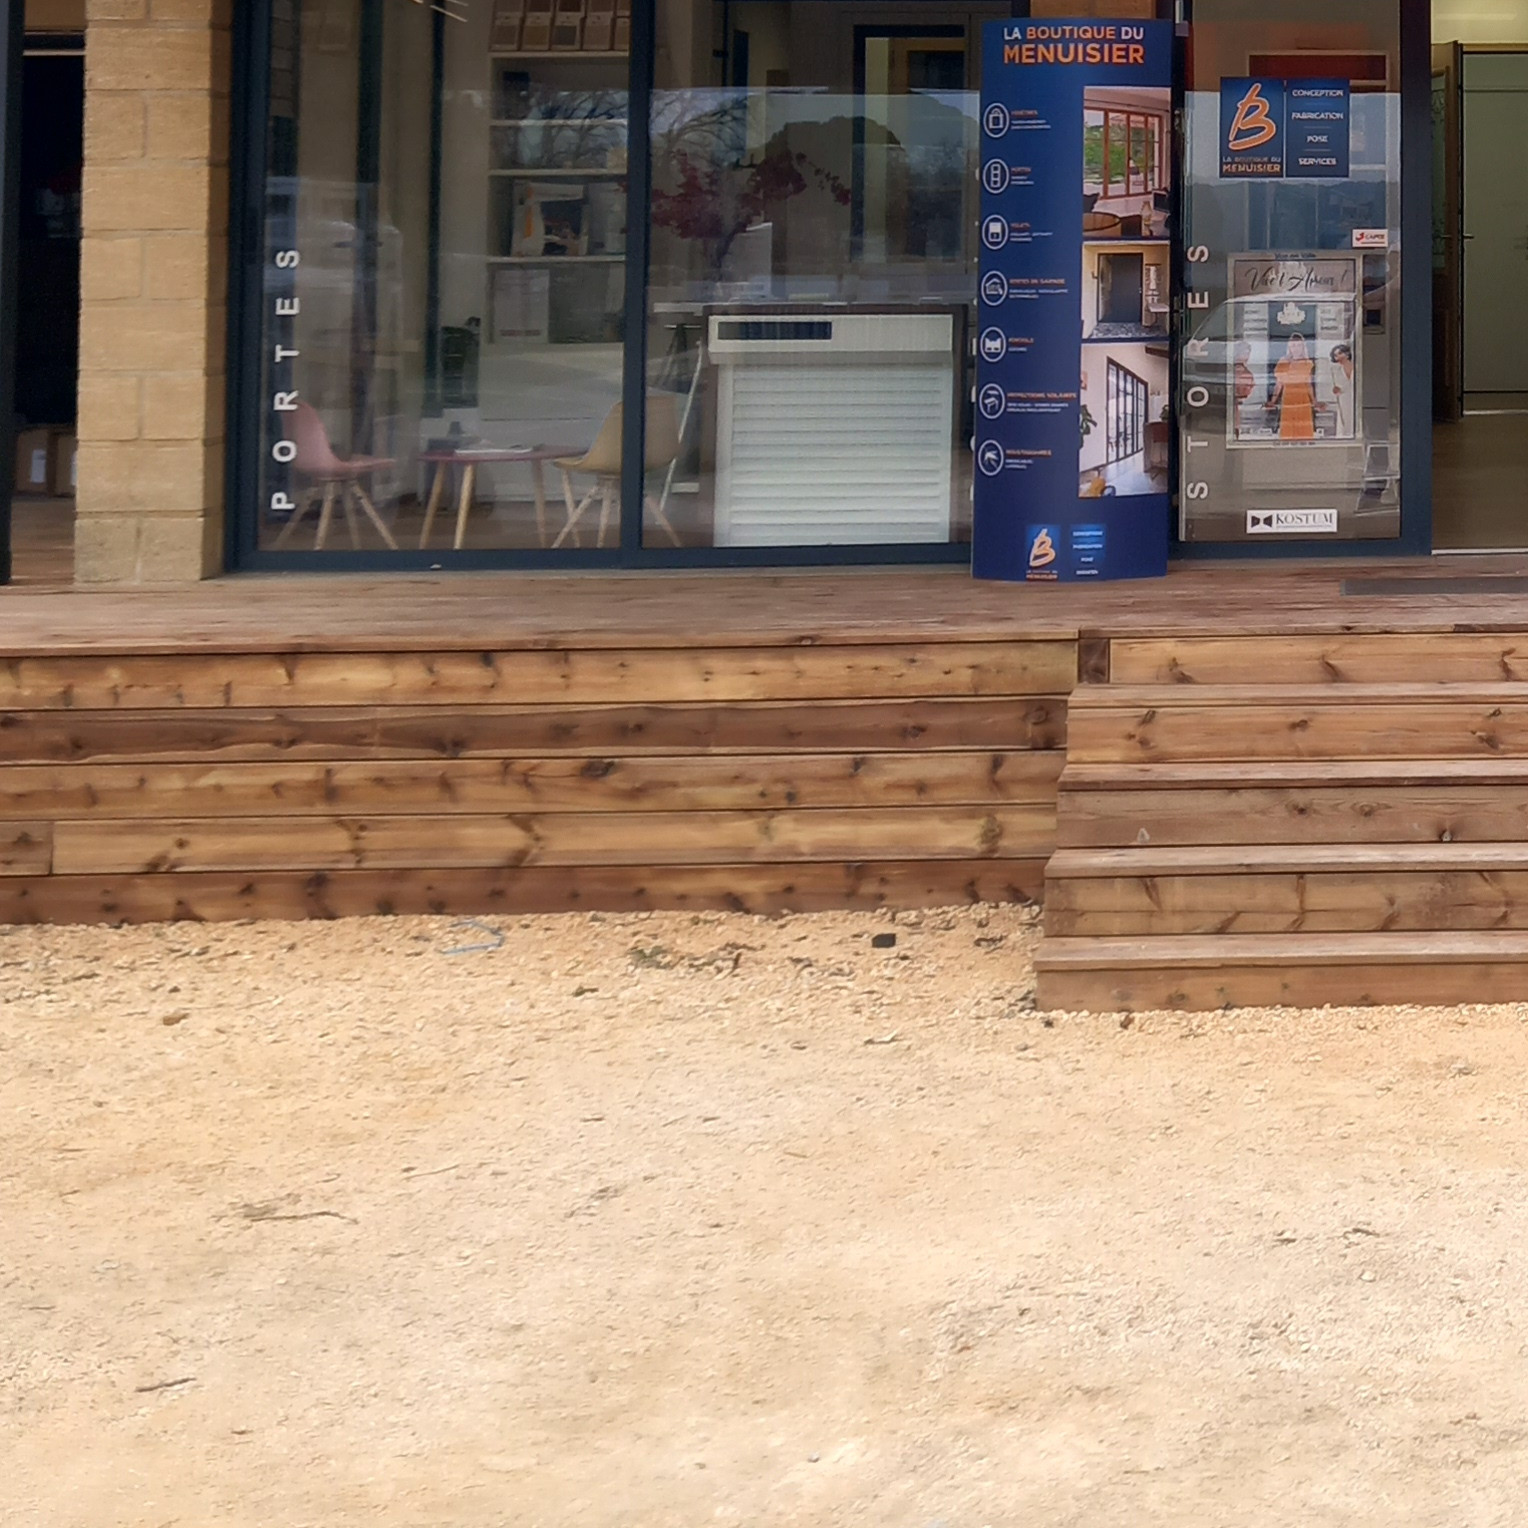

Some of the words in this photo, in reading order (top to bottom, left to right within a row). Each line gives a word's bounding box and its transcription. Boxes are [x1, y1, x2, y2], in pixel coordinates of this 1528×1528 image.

[1004, 27, 1021, 40] LA
[1026, 26, 1116, 39] BOUTIQUE
[1121, 27, 1144, 40] DU
[1004, 43, 1144, 64] MENUISIER
[271, 250, 300, 510] PORTES
[1187, 245, 1209, 499] STORES
[1276, 513, 1333, 524] KOSTUM
